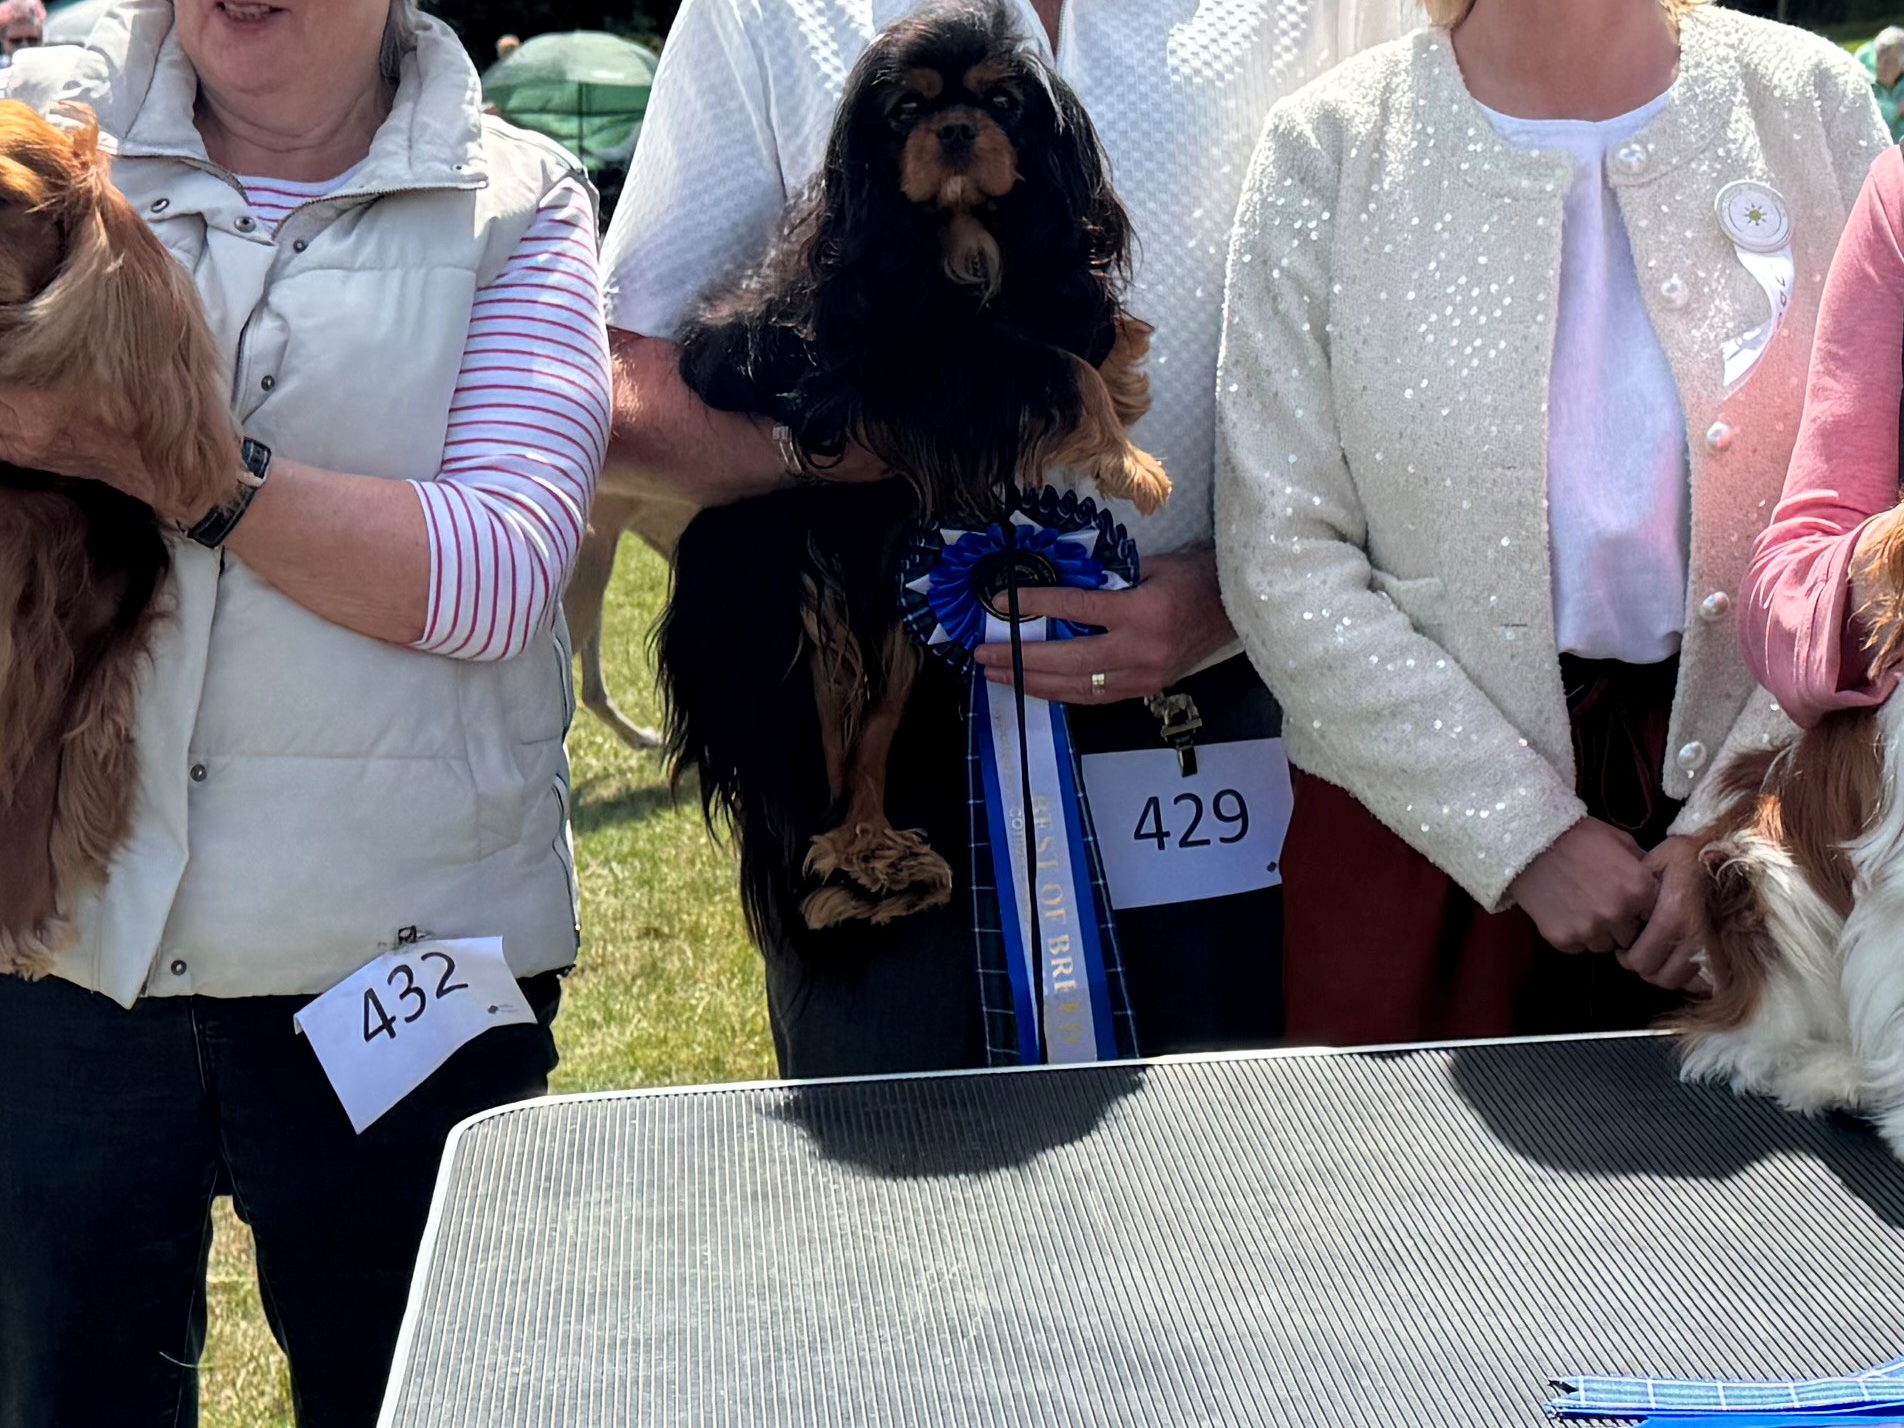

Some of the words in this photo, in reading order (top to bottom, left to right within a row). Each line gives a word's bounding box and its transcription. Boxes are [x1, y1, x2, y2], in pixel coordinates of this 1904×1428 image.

[1134, 788, 1249, 851] 429
[1040, 882, 1068, 926] OF
[363, 951, 469, 1042] 432
